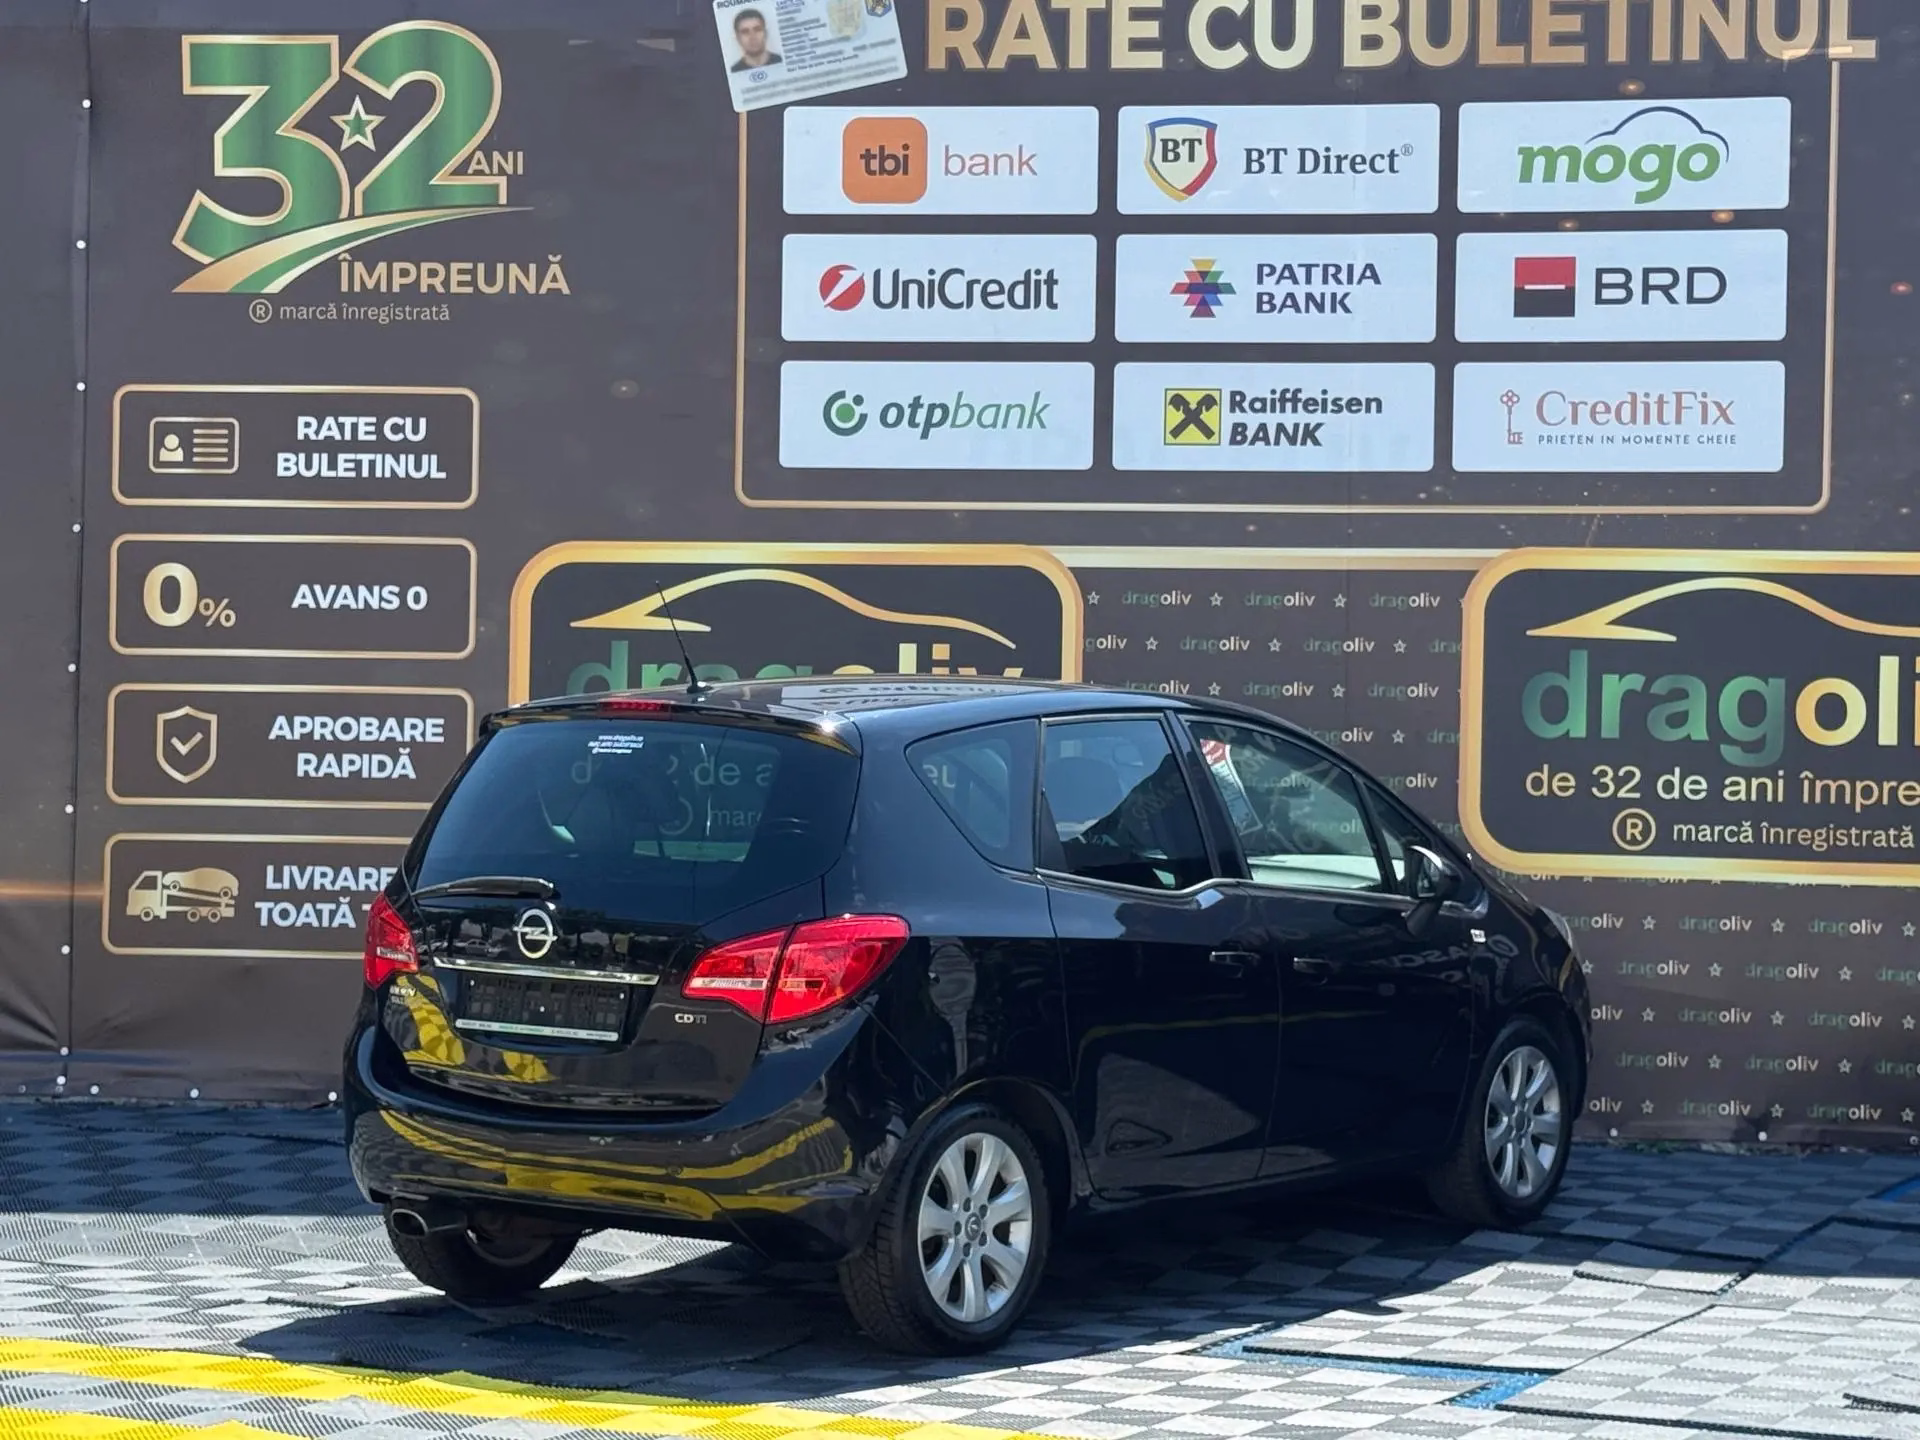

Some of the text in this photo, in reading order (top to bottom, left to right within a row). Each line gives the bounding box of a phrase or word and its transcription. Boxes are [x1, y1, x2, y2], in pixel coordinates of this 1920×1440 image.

[926, 0, 1165, 69] RATE
[1186, 0, 1314, 69] CU
[1343, 0, 1879, 68] BULETINUL
[172, 19, 507, 265] 32
[1160, 138, 1202, 163] BT
[467, 151, 524, 175] ANI
[859, 143, 1038, 176] tbi bank
[1243, 148, 1288, 175] BT
[1517, 142, 1721, 204] mogo
[337, 253, 571, 295] ÎMPREUNĂ
[1255, 263, 1382, 286] PATRIA
[1594, 266, 1728, 306] BRD
[871, 267, 1059, 311] UniCredit
[1255, 291, 1353, 315] BANK
[280, 304, 338, 320] marcă
[341, 303, 450, 324] înregistrată
[878, 390, 1052, 440] otpbank
[1228, 389, 1384, 416] Raiffeisen
[1535, 390, 1736, 427] CreditFix
[296, 416, 427, 442] RATE CU
[1228, 421, 1324, 447] BANK
[1538, 434, 1737, 445] PRIETEN IN MOMENTE CHEIE
[276, 453, 447, 479] BULETINUL
[291, 584, 428, 611] AVANS 0
[268, 715, 445, 743] APROBARE
[296, 747, 416, 779] RAPIDĂ
[1525, 764, 1576, 798] de
[1591, 765, 1642, 799] 32
[1656, 767, 1708, 801] de
[1722, 769, 1785, 803] ani
[1672, 821, 1754, 844] marcă
[1760, 821, 1915, 851] înregistrată
[254, 898, 356, 928] TOATĂ
